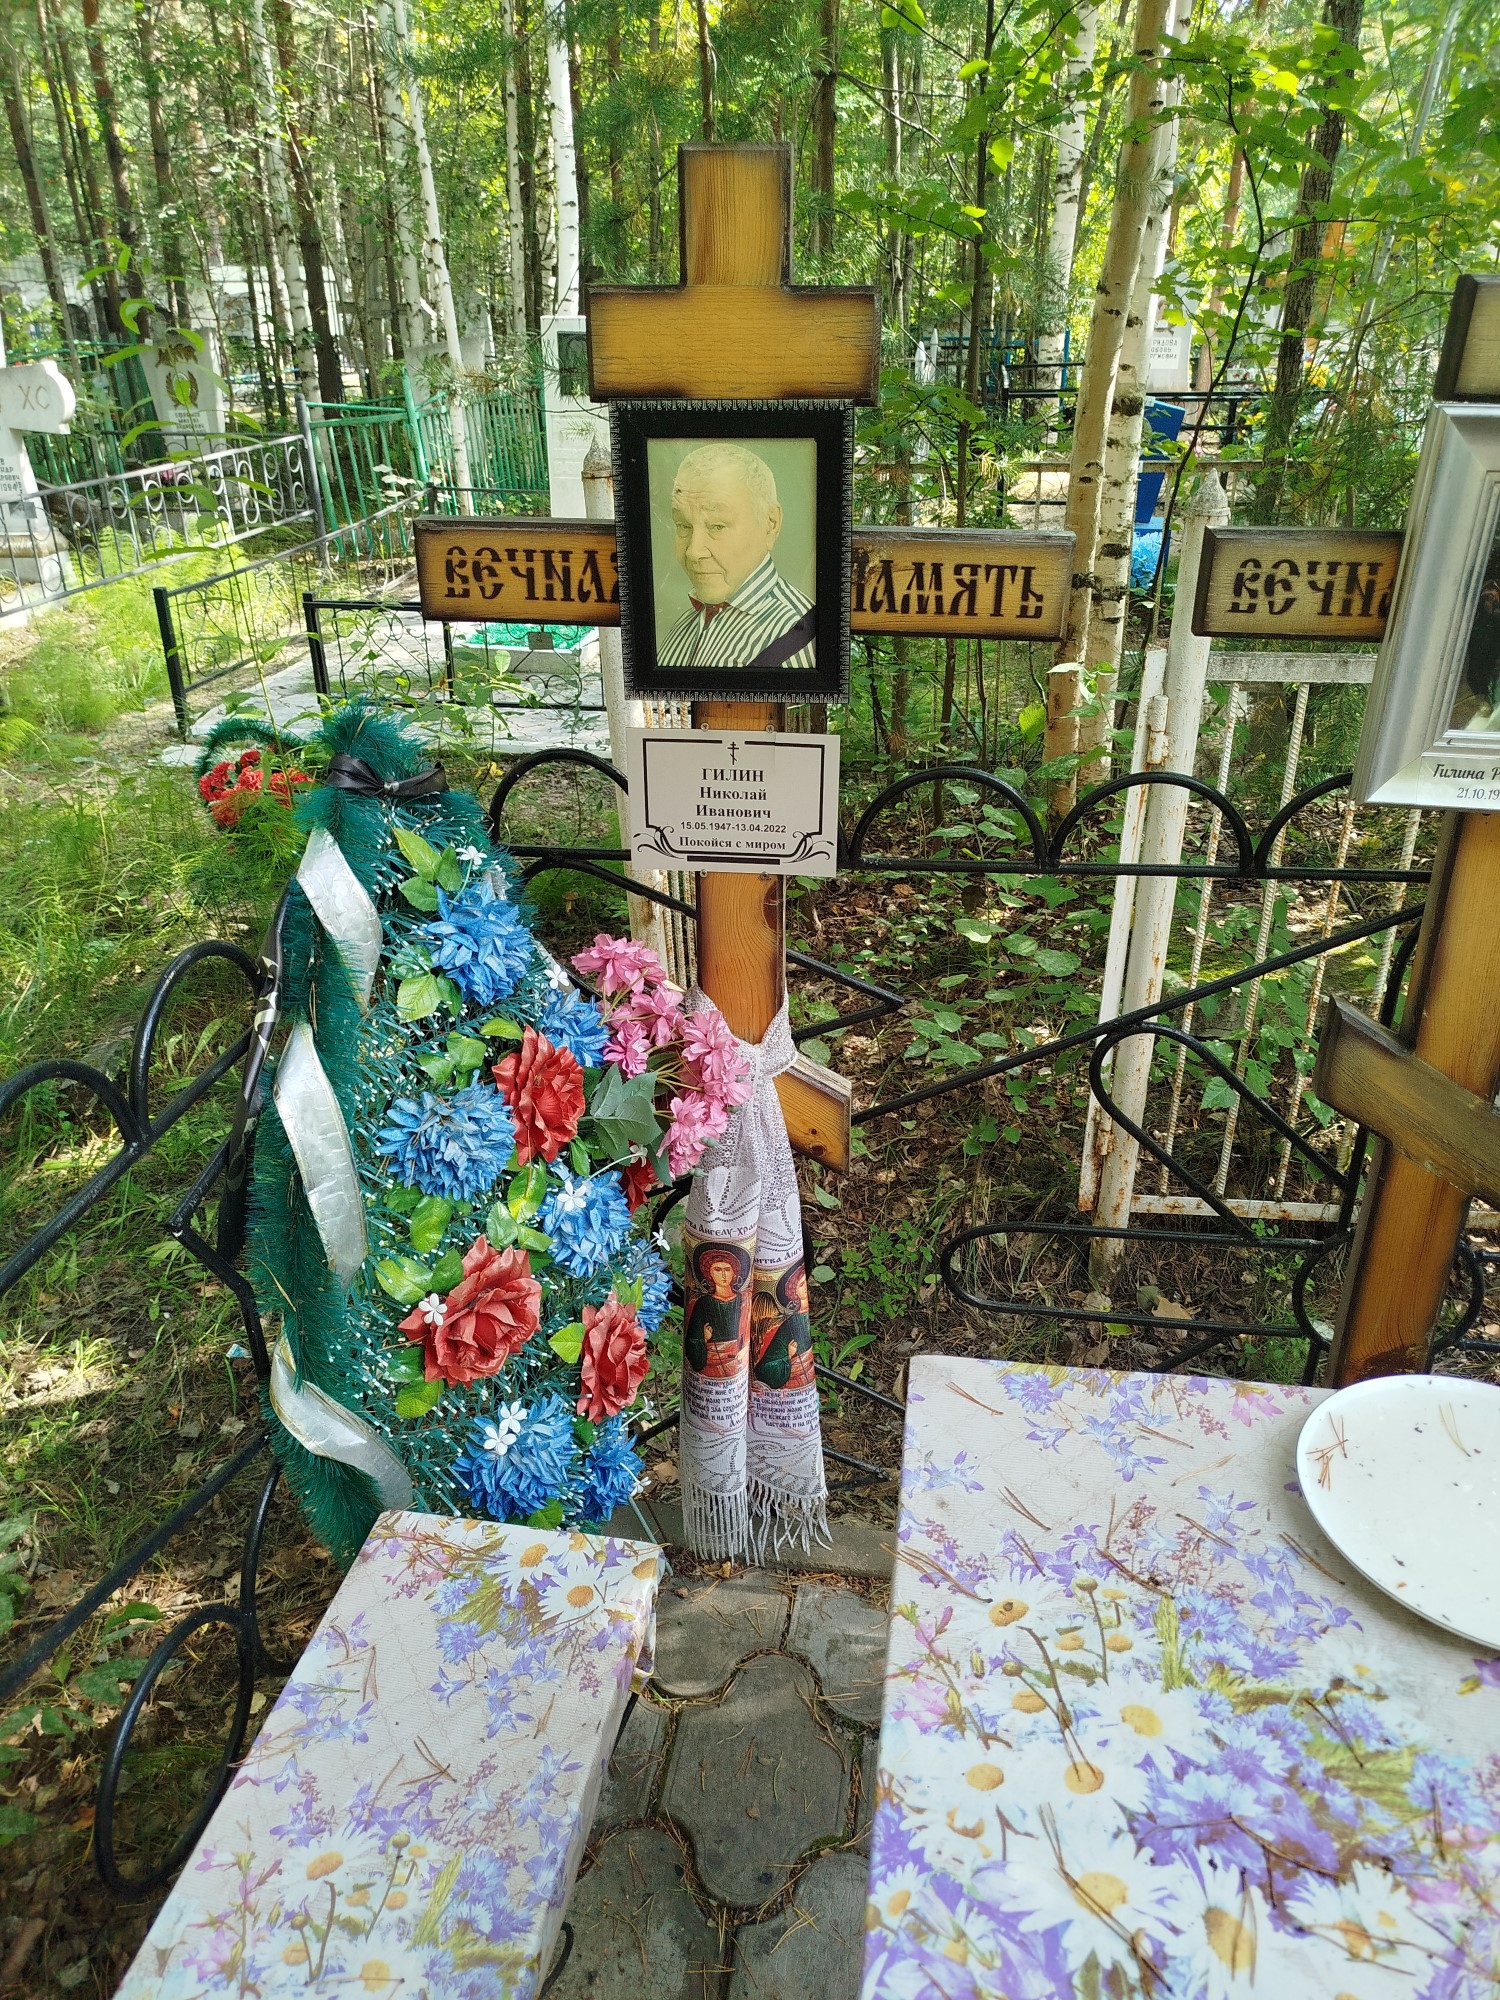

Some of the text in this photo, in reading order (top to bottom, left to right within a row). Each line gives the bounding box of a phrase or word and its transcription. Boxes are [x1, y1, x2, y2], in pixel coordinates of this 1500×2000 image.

[701, 768, 764, 782] ГИЛИН
[1432, 763, 1485, 780] Гилина
[699, 786, 767, 801] Николай
[696, 804, 771, 819] Иванович
[680, 821, 787, 834] 15.05.1947-13.04.2022
[679, 836, 732, 848] Покойся
[745, 842, 786, 852] миром
